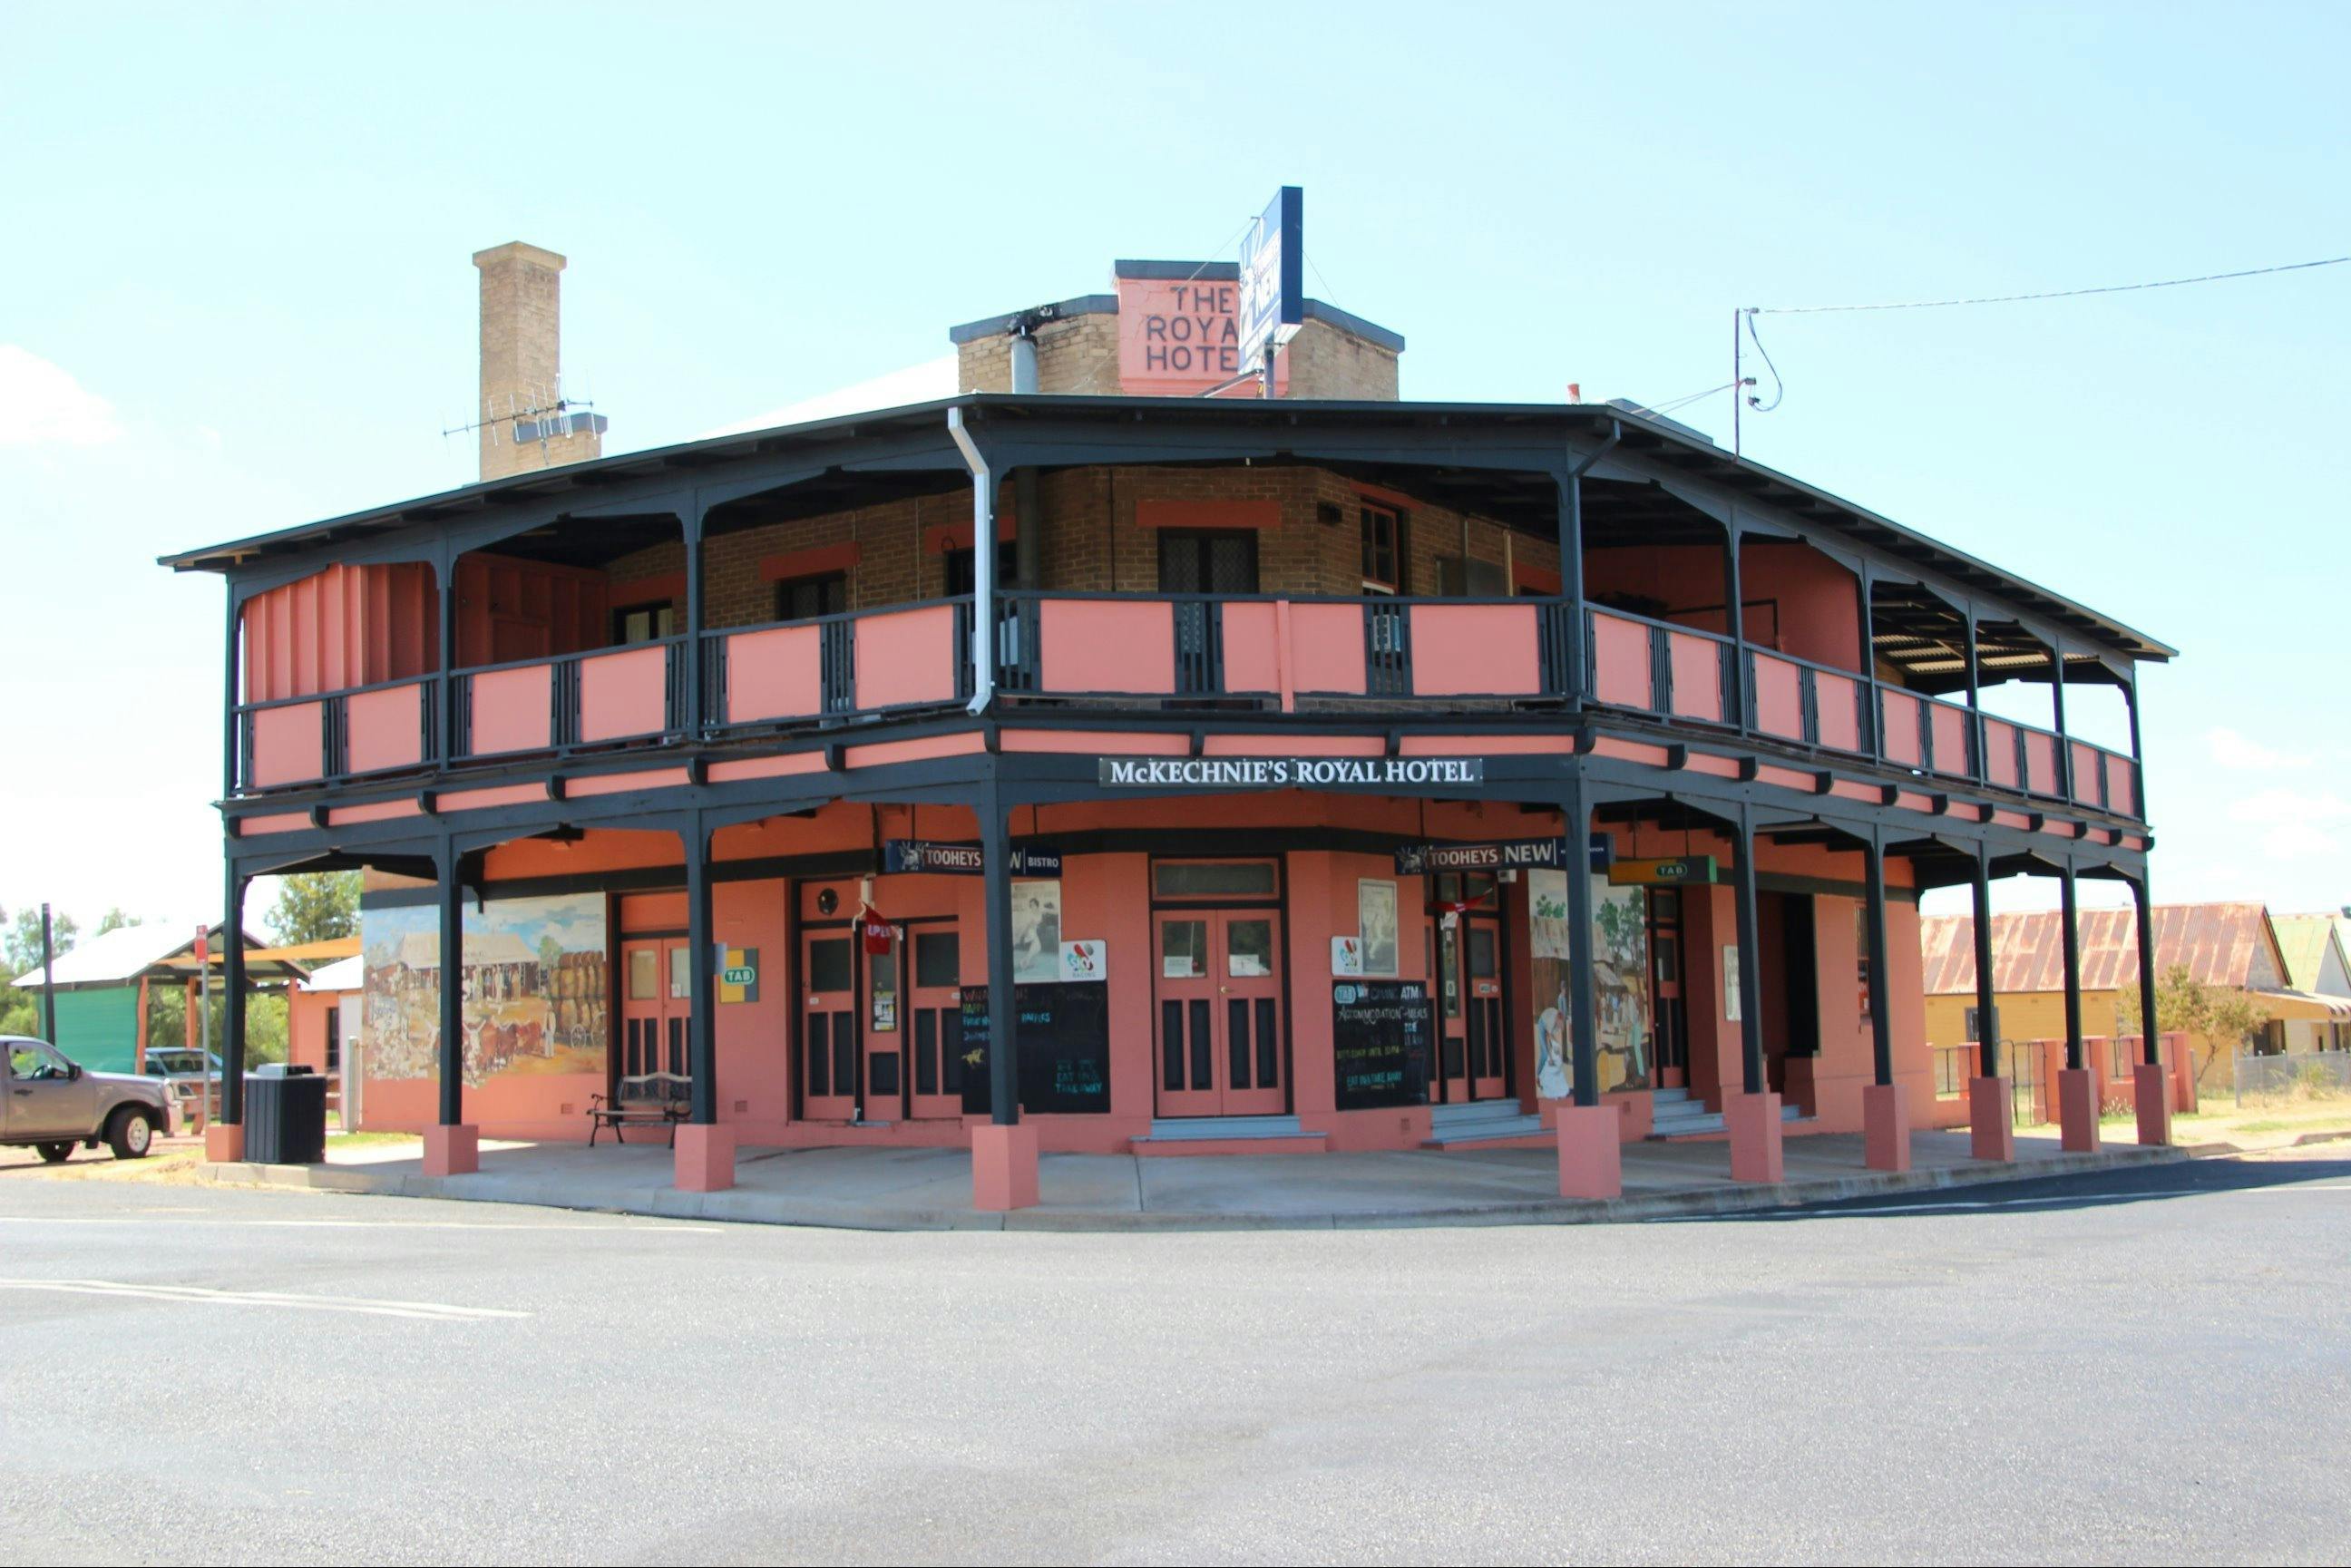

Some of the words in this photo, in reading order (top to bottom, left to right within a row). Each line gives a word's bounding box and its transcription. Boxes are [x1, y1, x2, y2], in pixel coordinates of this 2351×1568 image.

[1170, 286, 1234, 314] THE
[1146, 316, 1240, 342] ROYA
[1146, 345, 1239, 373] HOTE
[1110, 760, 1288, 784] McKECHNIE'S
[1295, 760, 1383, 783] ROYAL
[1385, 759, 1475, 783] HOTEL
[925, 849, 981, 867] TOOHEYS
[1027, 856, 1059, 868] BISTRO
[1431, 848, 1499, 866] TOOHEYS
[1503, 843, 1553, 863] NEW
[1659, 865, 1683, 876] TAB
[727, 970, 751, 981] TAB
